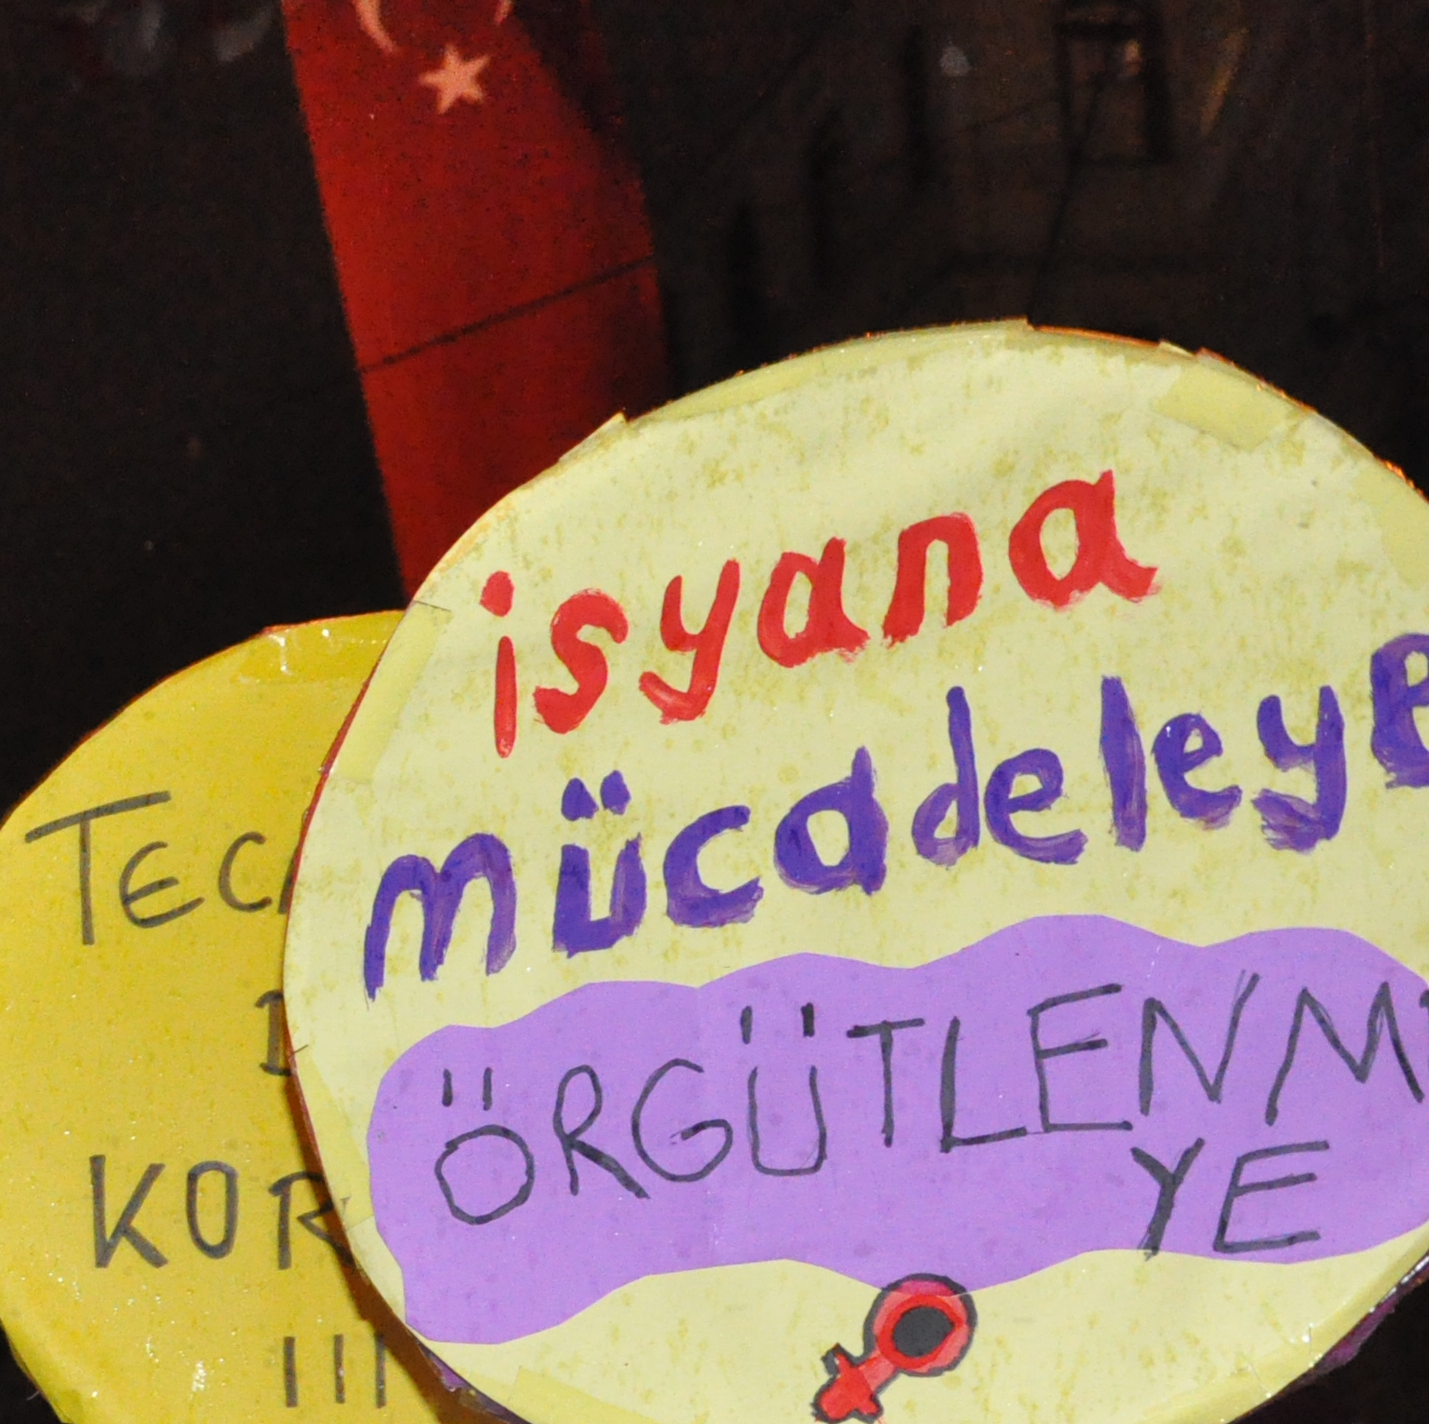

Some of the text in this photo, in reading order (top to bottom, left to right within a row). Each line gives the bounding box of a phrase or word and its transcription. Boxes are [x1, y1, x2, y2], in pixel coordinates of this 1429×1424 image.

[25, 790, 301, 946] TEC
[433, 970, 1429, 1226] ÖRGÜTLENM
[88, 1153, 355, 1271] KOR
[1130, 1137, 1330, 1262] YE
